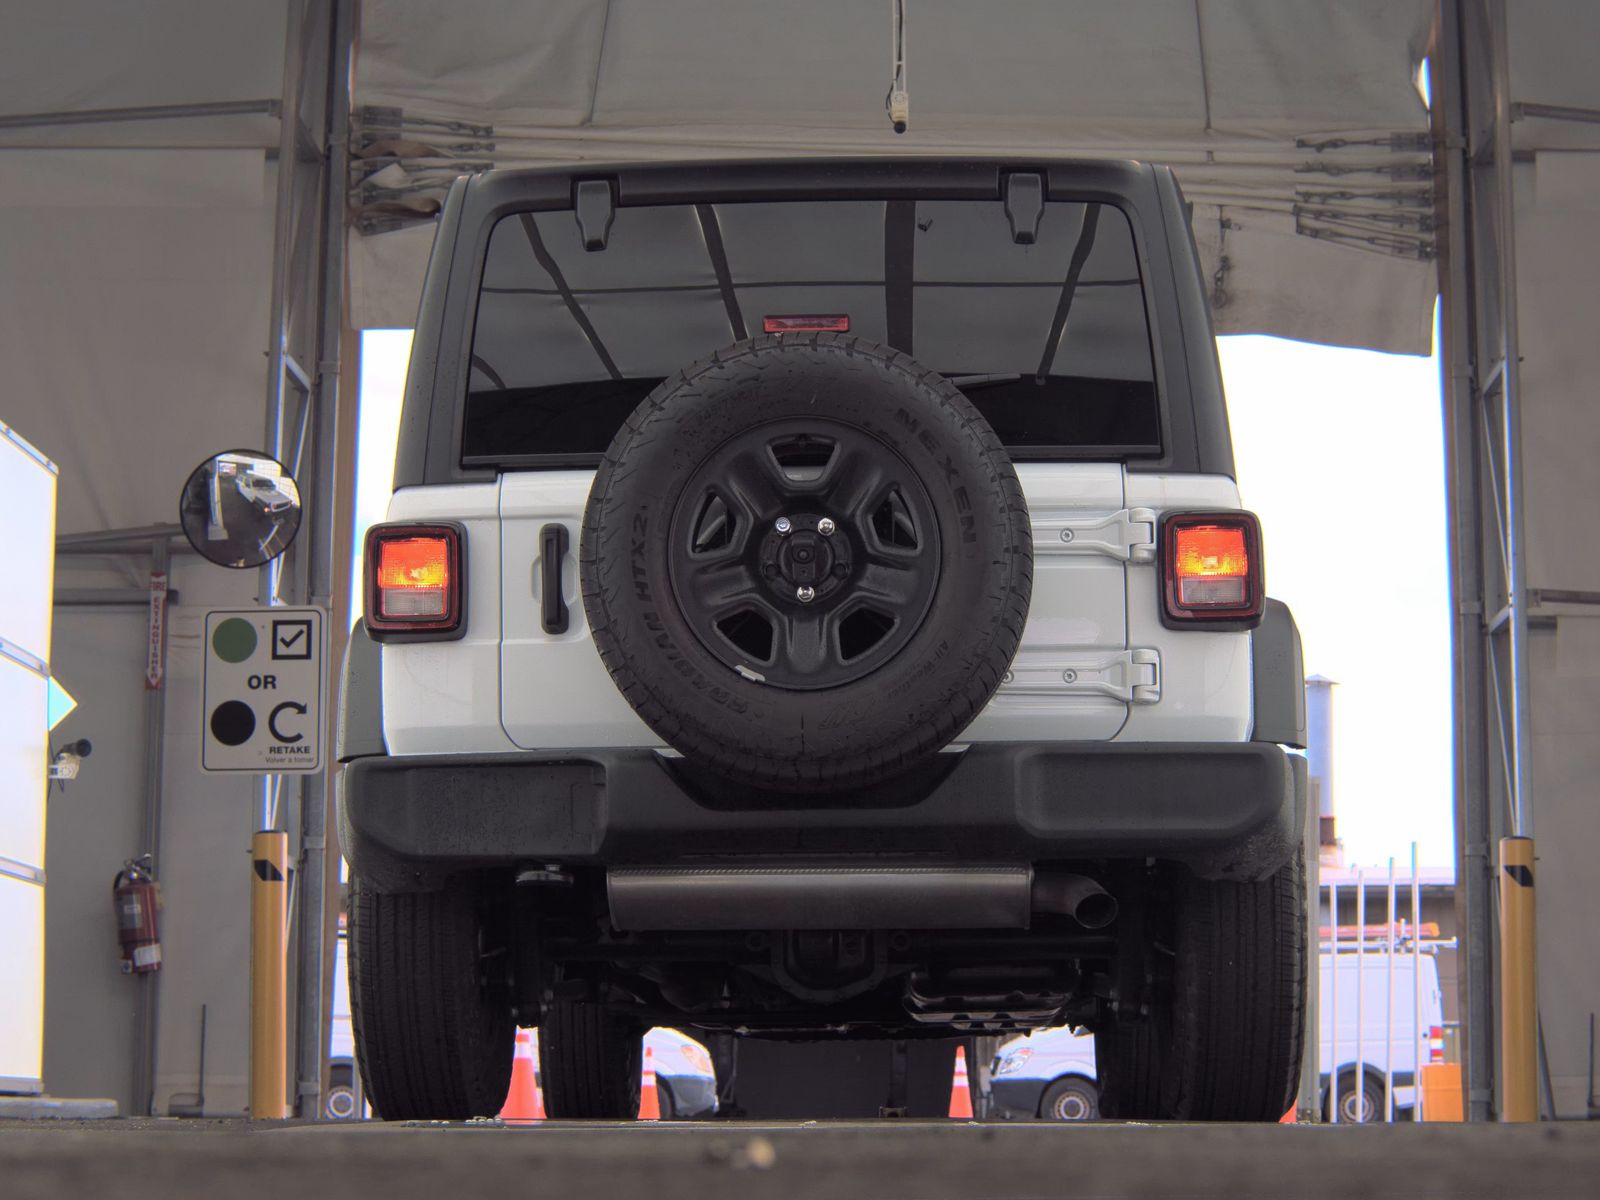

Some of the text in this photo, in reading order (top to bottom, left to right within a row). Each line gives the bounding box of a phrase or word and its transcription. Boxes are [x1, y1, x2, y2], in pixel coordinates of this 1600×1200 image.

[895, 408, 976, 543] NEXEN
[150, 582, 166, 592] FIRE
[151, 597, 160, 678] EXTINGUISHER
[631, 513, 748, 714] ROADIAN HTX2
[247, 674, 277, 690] OR
[269, 746, 311, 754] RETAKE
